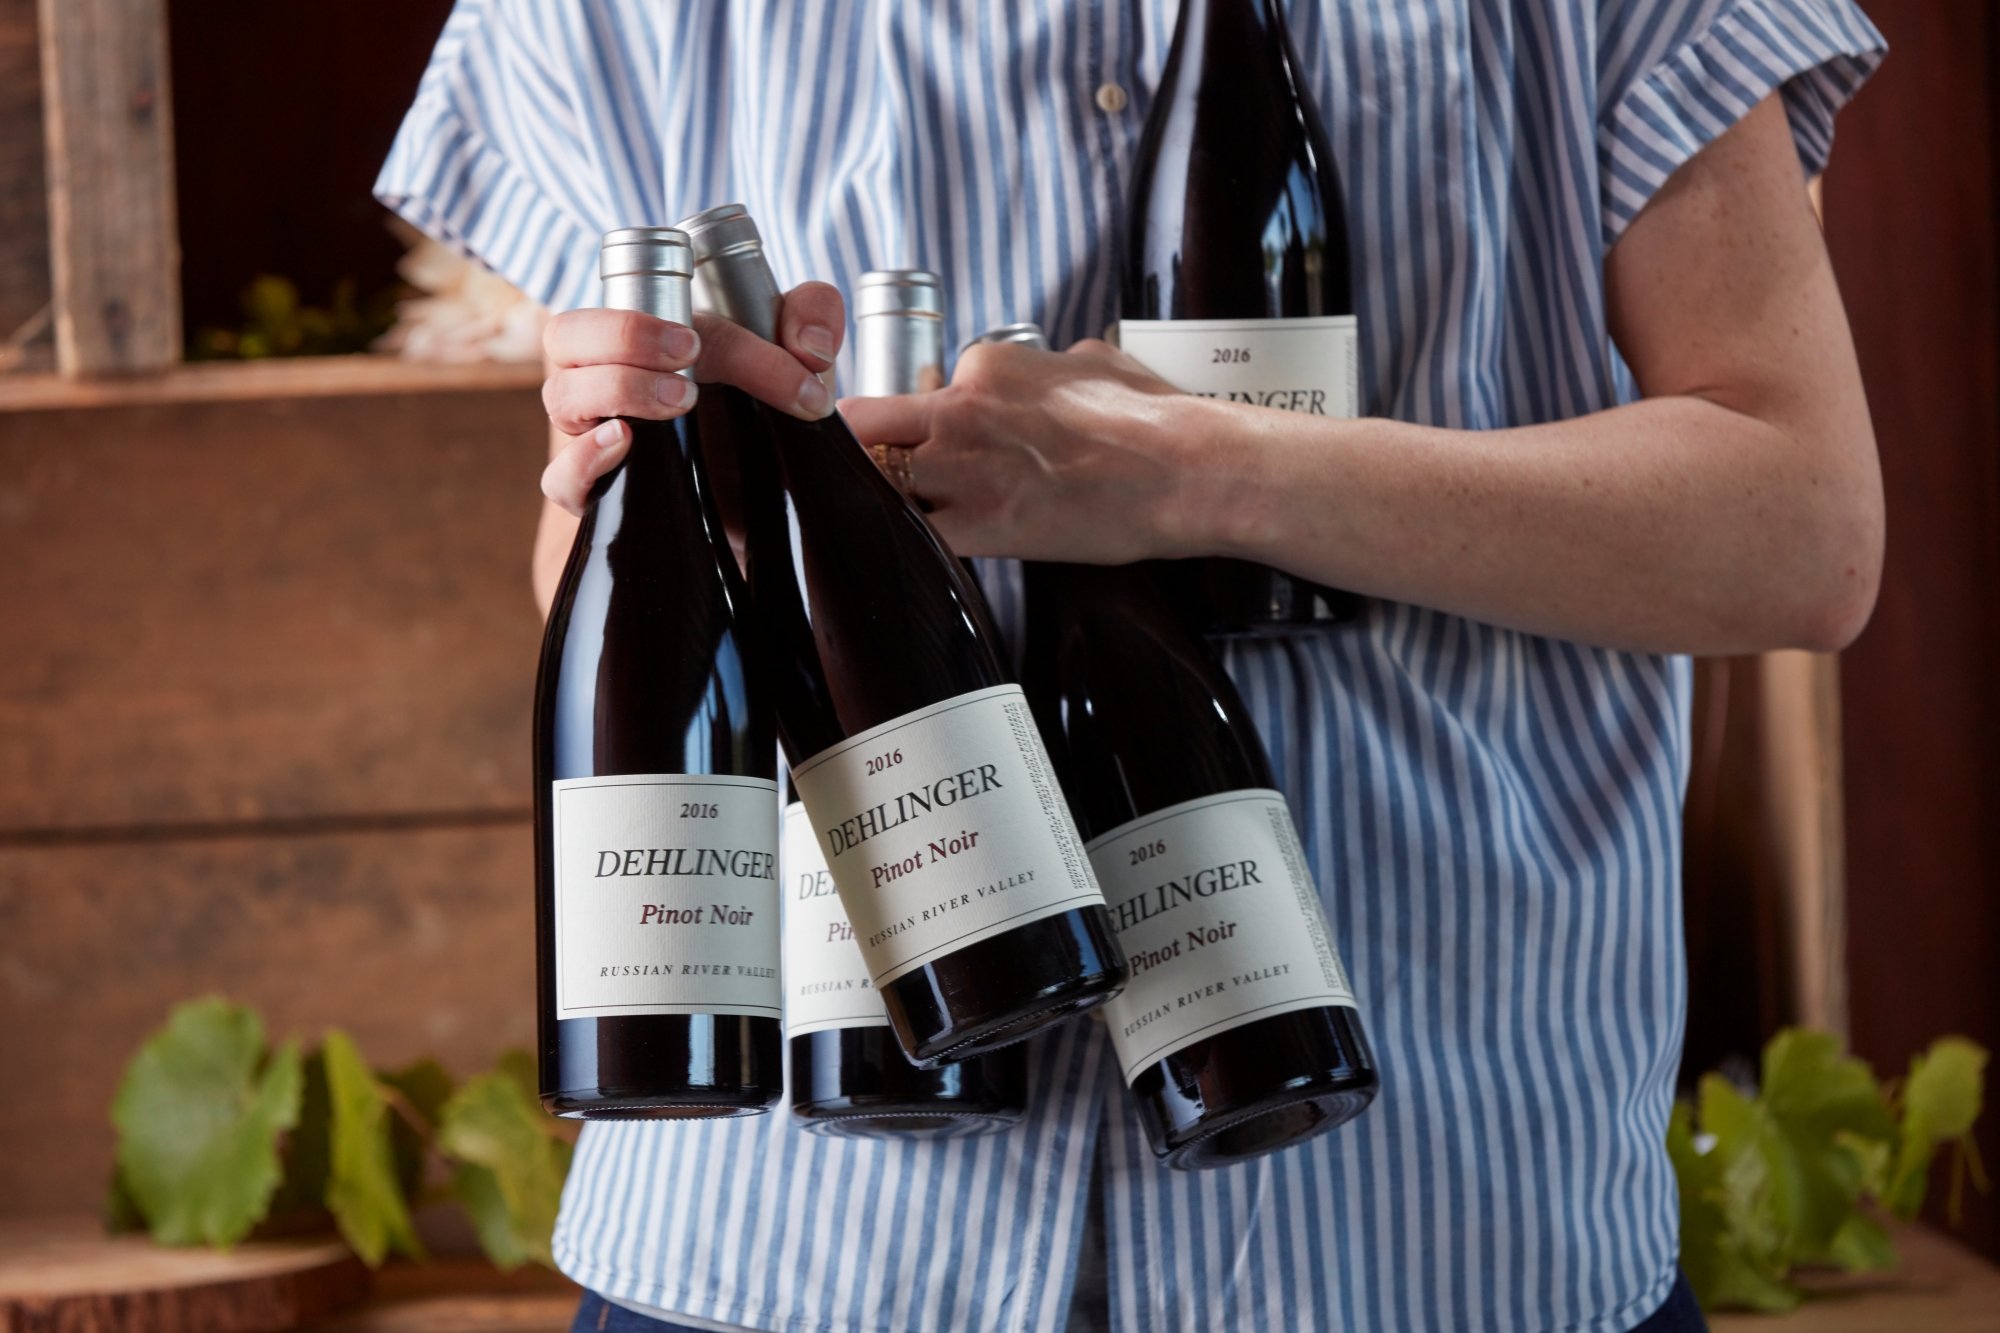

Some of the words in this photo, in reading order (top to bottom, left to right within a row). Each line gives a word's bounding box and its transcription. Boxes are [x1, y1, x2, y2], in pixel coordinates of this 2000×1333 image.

[1212, 347, 1251, 363] 2016
[865, 748, 903, 776] 2016
[680, 803, 720, 819] 2016
[827, 763, 1003, 857] DEHLINGER
[595, 849, 775, 880] DEHLINGER
[870, 850, 923, 889] Pinot
[928, 829, 979, 863] Noir
[1129, 839, 1167, 866] 2016
[640, 904, 704, 925] Pinot
[709, 904, 755, 926] Noir
[869, 916, 915, 948] RUSSIAN
[922, 893, 971, 922] RIVER
[976, 870, 1036, 899] VALLEY
[1130, 938, 1180, 977] Pinot
[1186, 920, 1237, 952] Noir
[600, 965, 673, 977] RUSSIAN
[681, 964, 732, 976] RIVER
[1124, 1002, 1172, 1038] RUSSIAN
[1178, 981, 1226, 1009] RIVER
[1233, 963, 1291, 987] VALLEY
